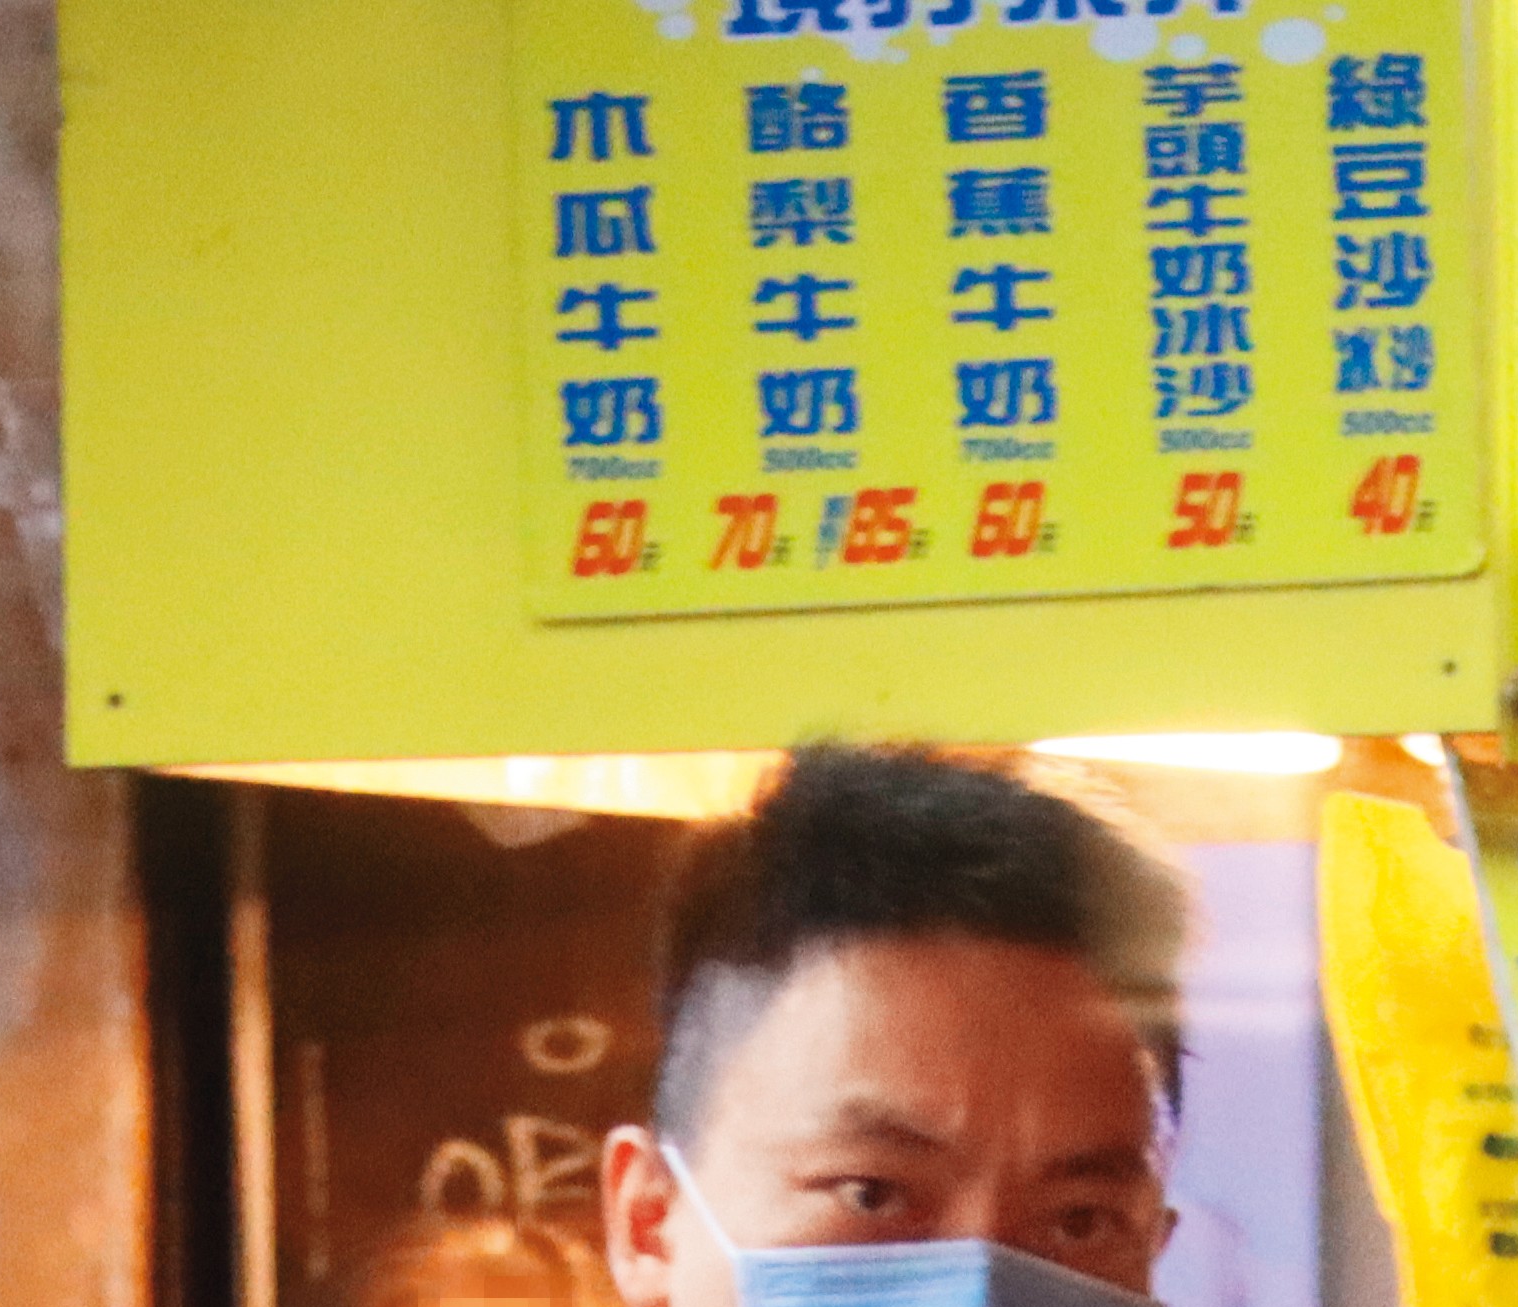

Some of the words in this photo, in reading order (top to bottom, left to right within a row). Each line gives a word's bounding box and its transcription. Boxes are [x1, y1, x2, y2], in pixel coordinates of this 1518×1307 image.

[548, 92, 662, 447] 木瓜牛奶
[746, 82, 860, 437] 酪梨牛奶
[944, 71, 1058, 428] 香蕉牛奶
[1140, 60, 1252, 418] 芋頭牛奶冰沙
